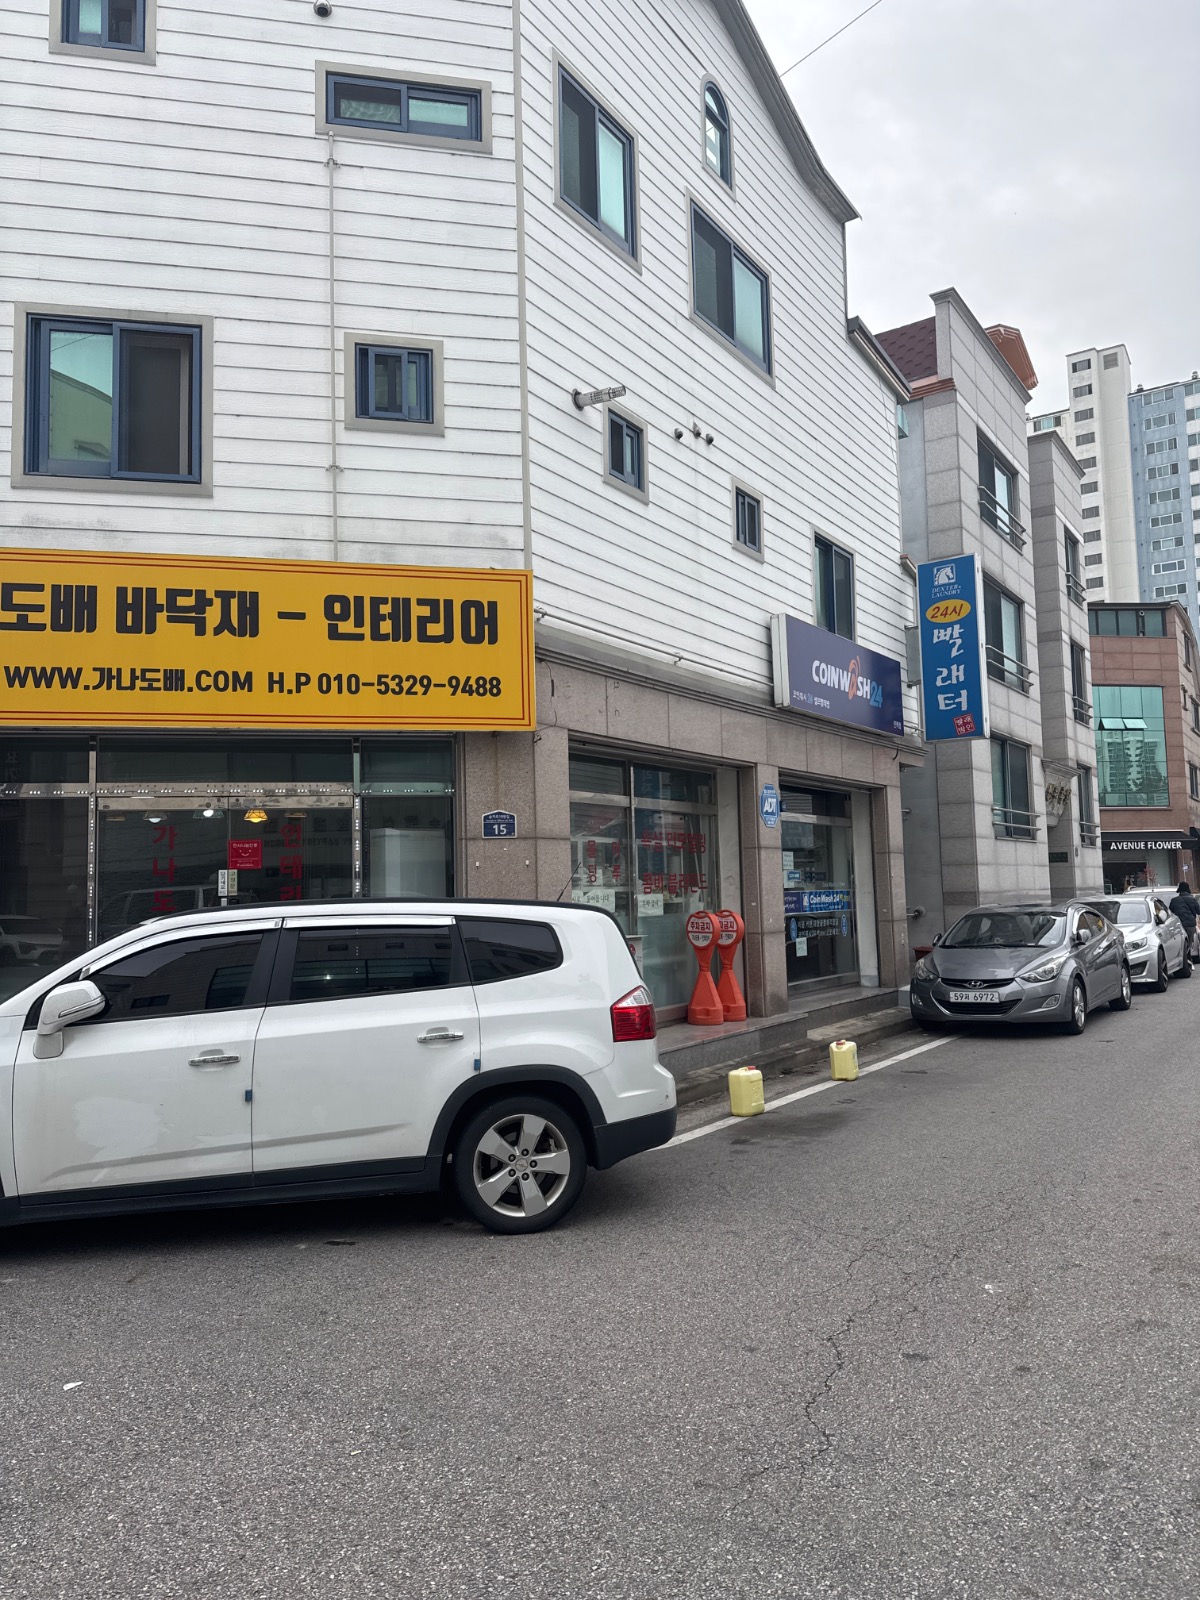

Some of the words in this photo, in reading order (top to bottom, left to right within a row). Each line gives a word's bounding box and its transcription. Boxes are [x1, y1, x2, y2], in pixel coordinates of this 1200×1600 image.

[931, 589, 961, 598] LAUNDRY
[0, 582, 98, 633] 도배
[116, 586, 260, 638] 바닥재
[323, 594, 499, 645] 인테리어
[930, 603, 964, 619] 24시
[932, 623, 968, 711] 빨래터
[4, 666, 253, 692] WWW.가나도배.COM
[267, 671, 311, 694] H.P
[317, 672, 502, 697] 010-5329-9488
[763, 798, 777, 813] ADT
[493, 824, 507, 835] 15
[1110, 841, 1146, 850] AVENUE
[1147, 841, 1182, 849] FLOWER
[810, 895, 821, 904] Coin
[821, 894, 833, 903] Wash
[690, 921, 711, 930] 주차금지
[718, 920, 735, 929] 차금지
[973, 992, 995, 1001] 6972
